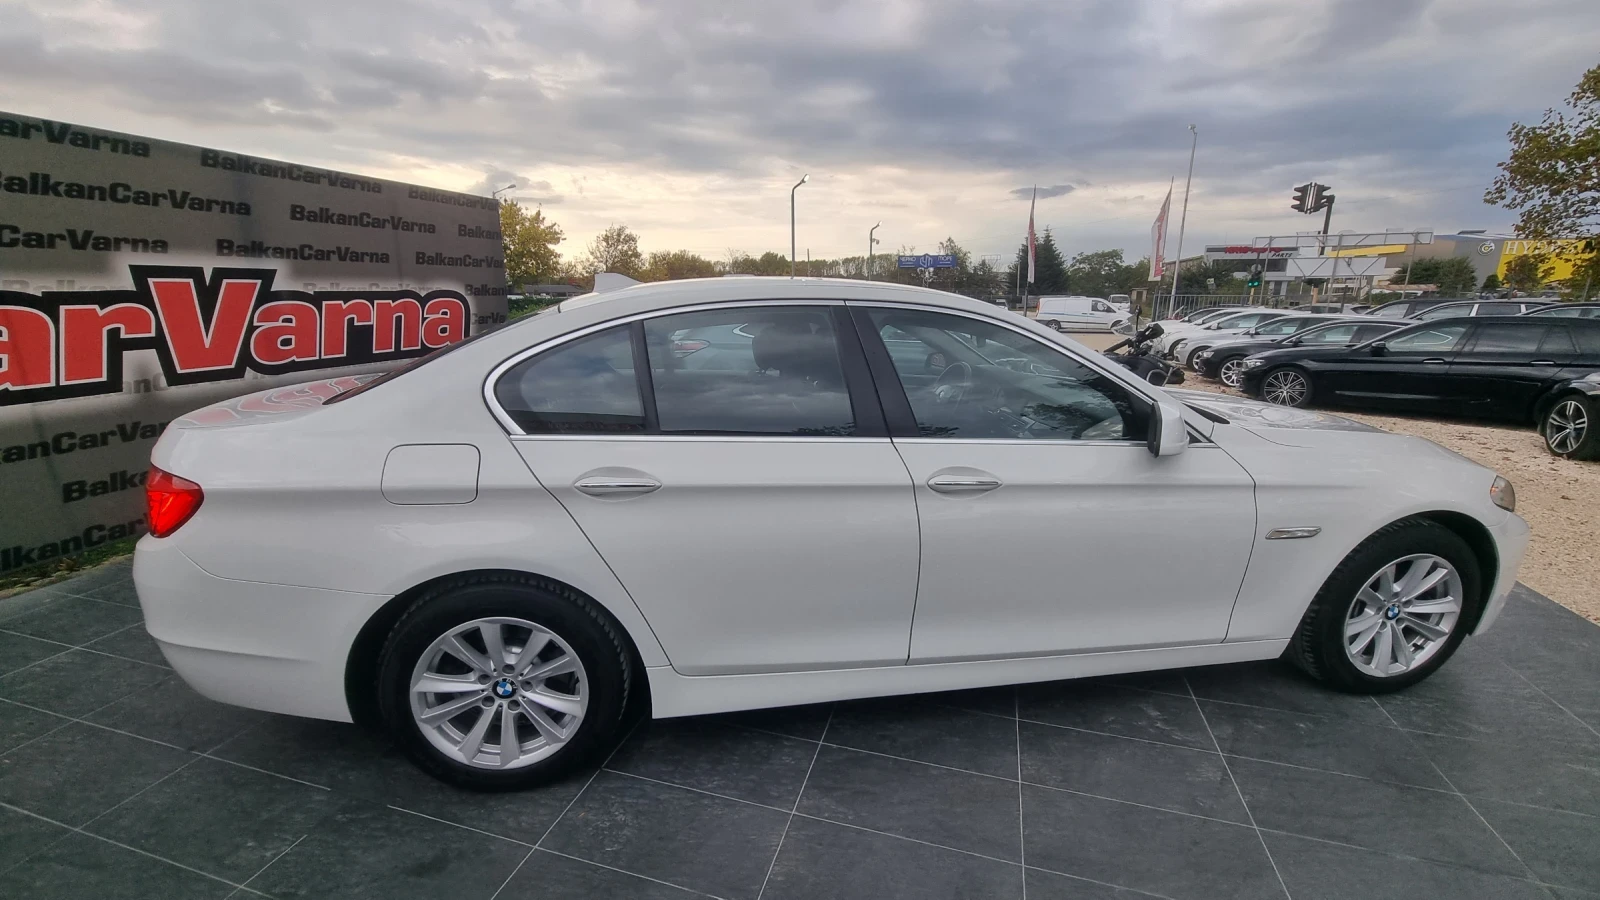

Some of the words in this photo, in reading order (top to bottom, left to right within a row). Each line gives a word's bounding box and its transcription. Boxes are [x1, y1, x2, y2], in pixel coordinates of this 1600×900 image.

[200, 148, 382, 193] BalkanCarVarna
[0, 171, 251, 216] alkanCarVarna
[289, 205, 436, 234] BalkanCarVarna
[458, 223, 502, 240] Balkan
[216, 239, 390, 264] BalkanCarVarna
[464, 284, 506, 297] Balkan
[0, 421, 171, 465] anCarVa
